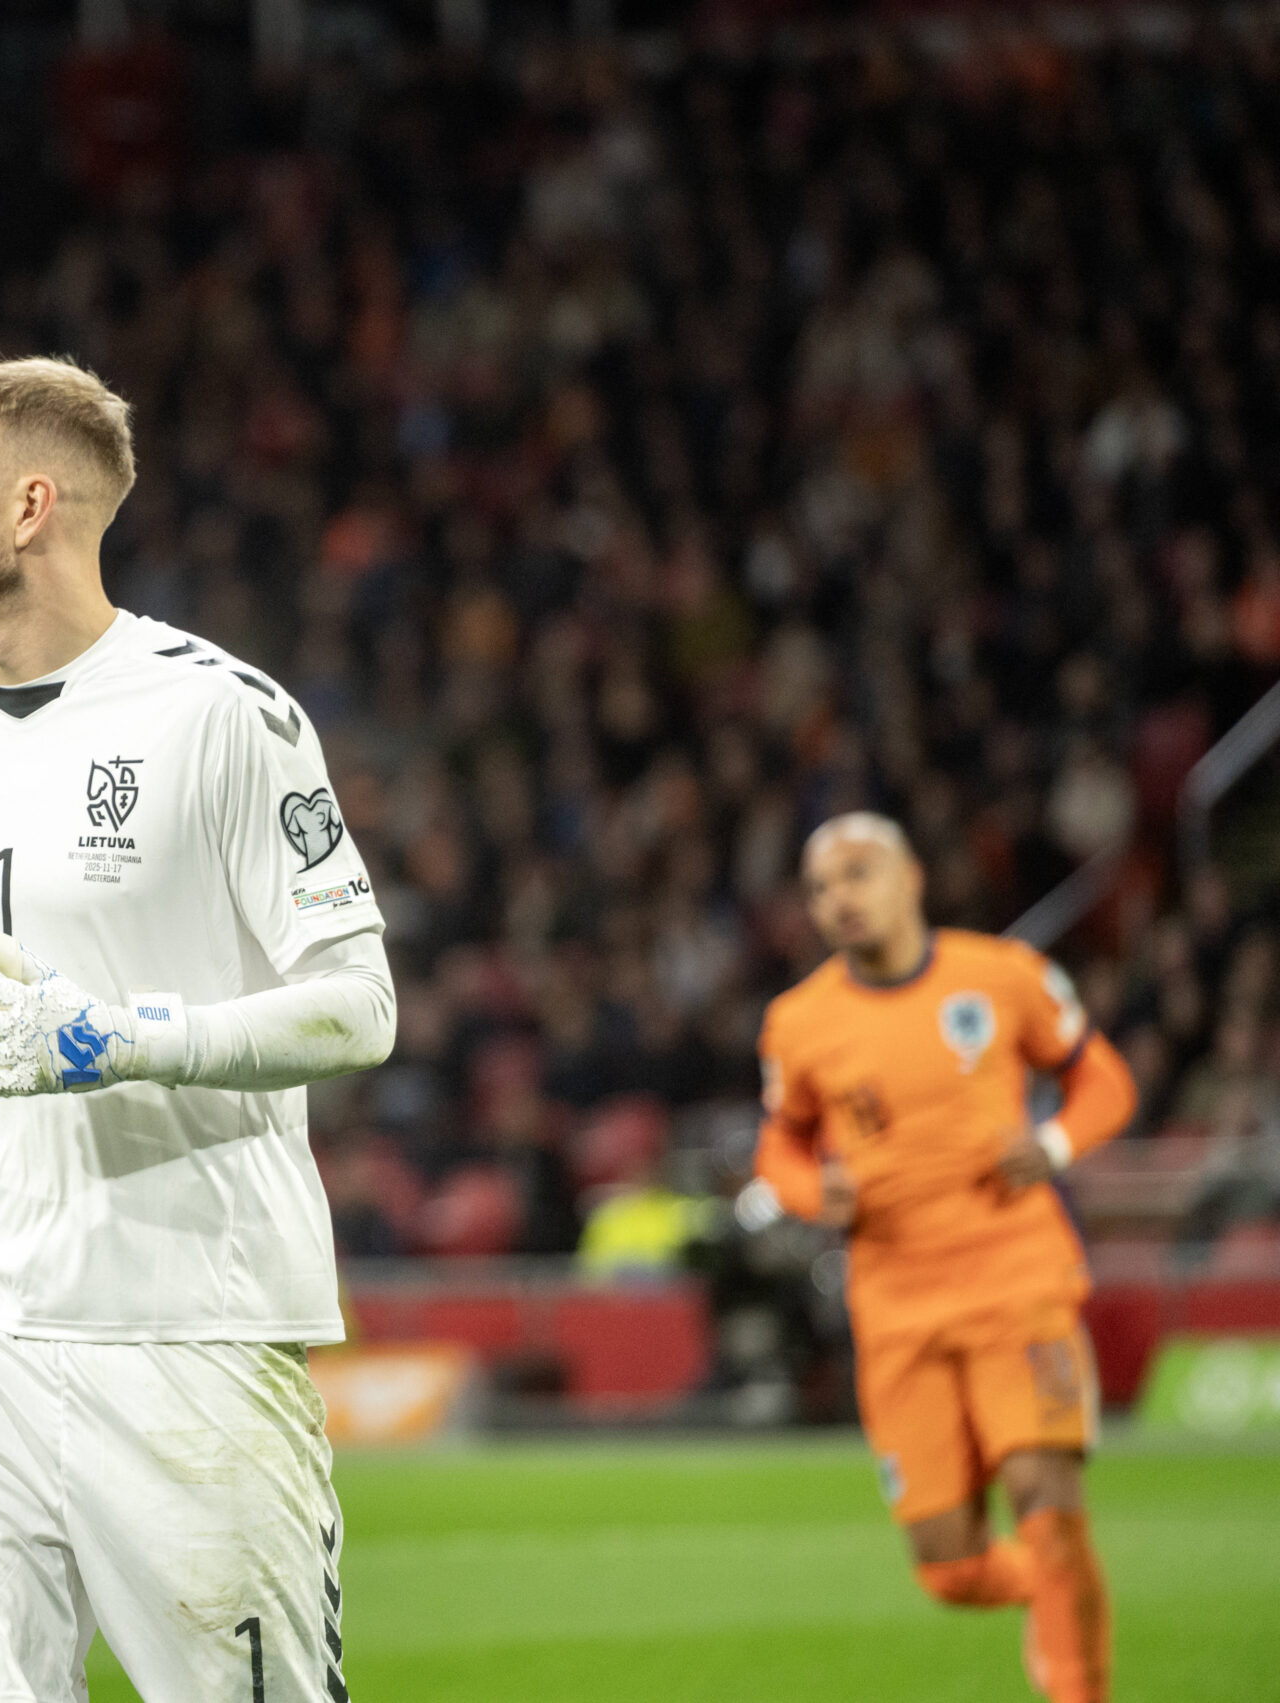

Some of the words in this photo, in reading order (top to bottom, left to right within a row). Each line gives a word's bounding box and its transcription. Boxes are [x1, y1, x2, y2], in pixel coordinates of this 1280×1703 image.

[77, 836, 136, 850] LIETUVA
[111, 853, 142, 864] LITHUANIA
[84, 862, 122, 873] 2025-11-17
[83, 872, 121, 883] AMSTERDAM
[294, 888, 349, 907] FOUNDATION
[137, 1006, 170, 1022] AQUA
[234, 1616, 265, 1703] 1
